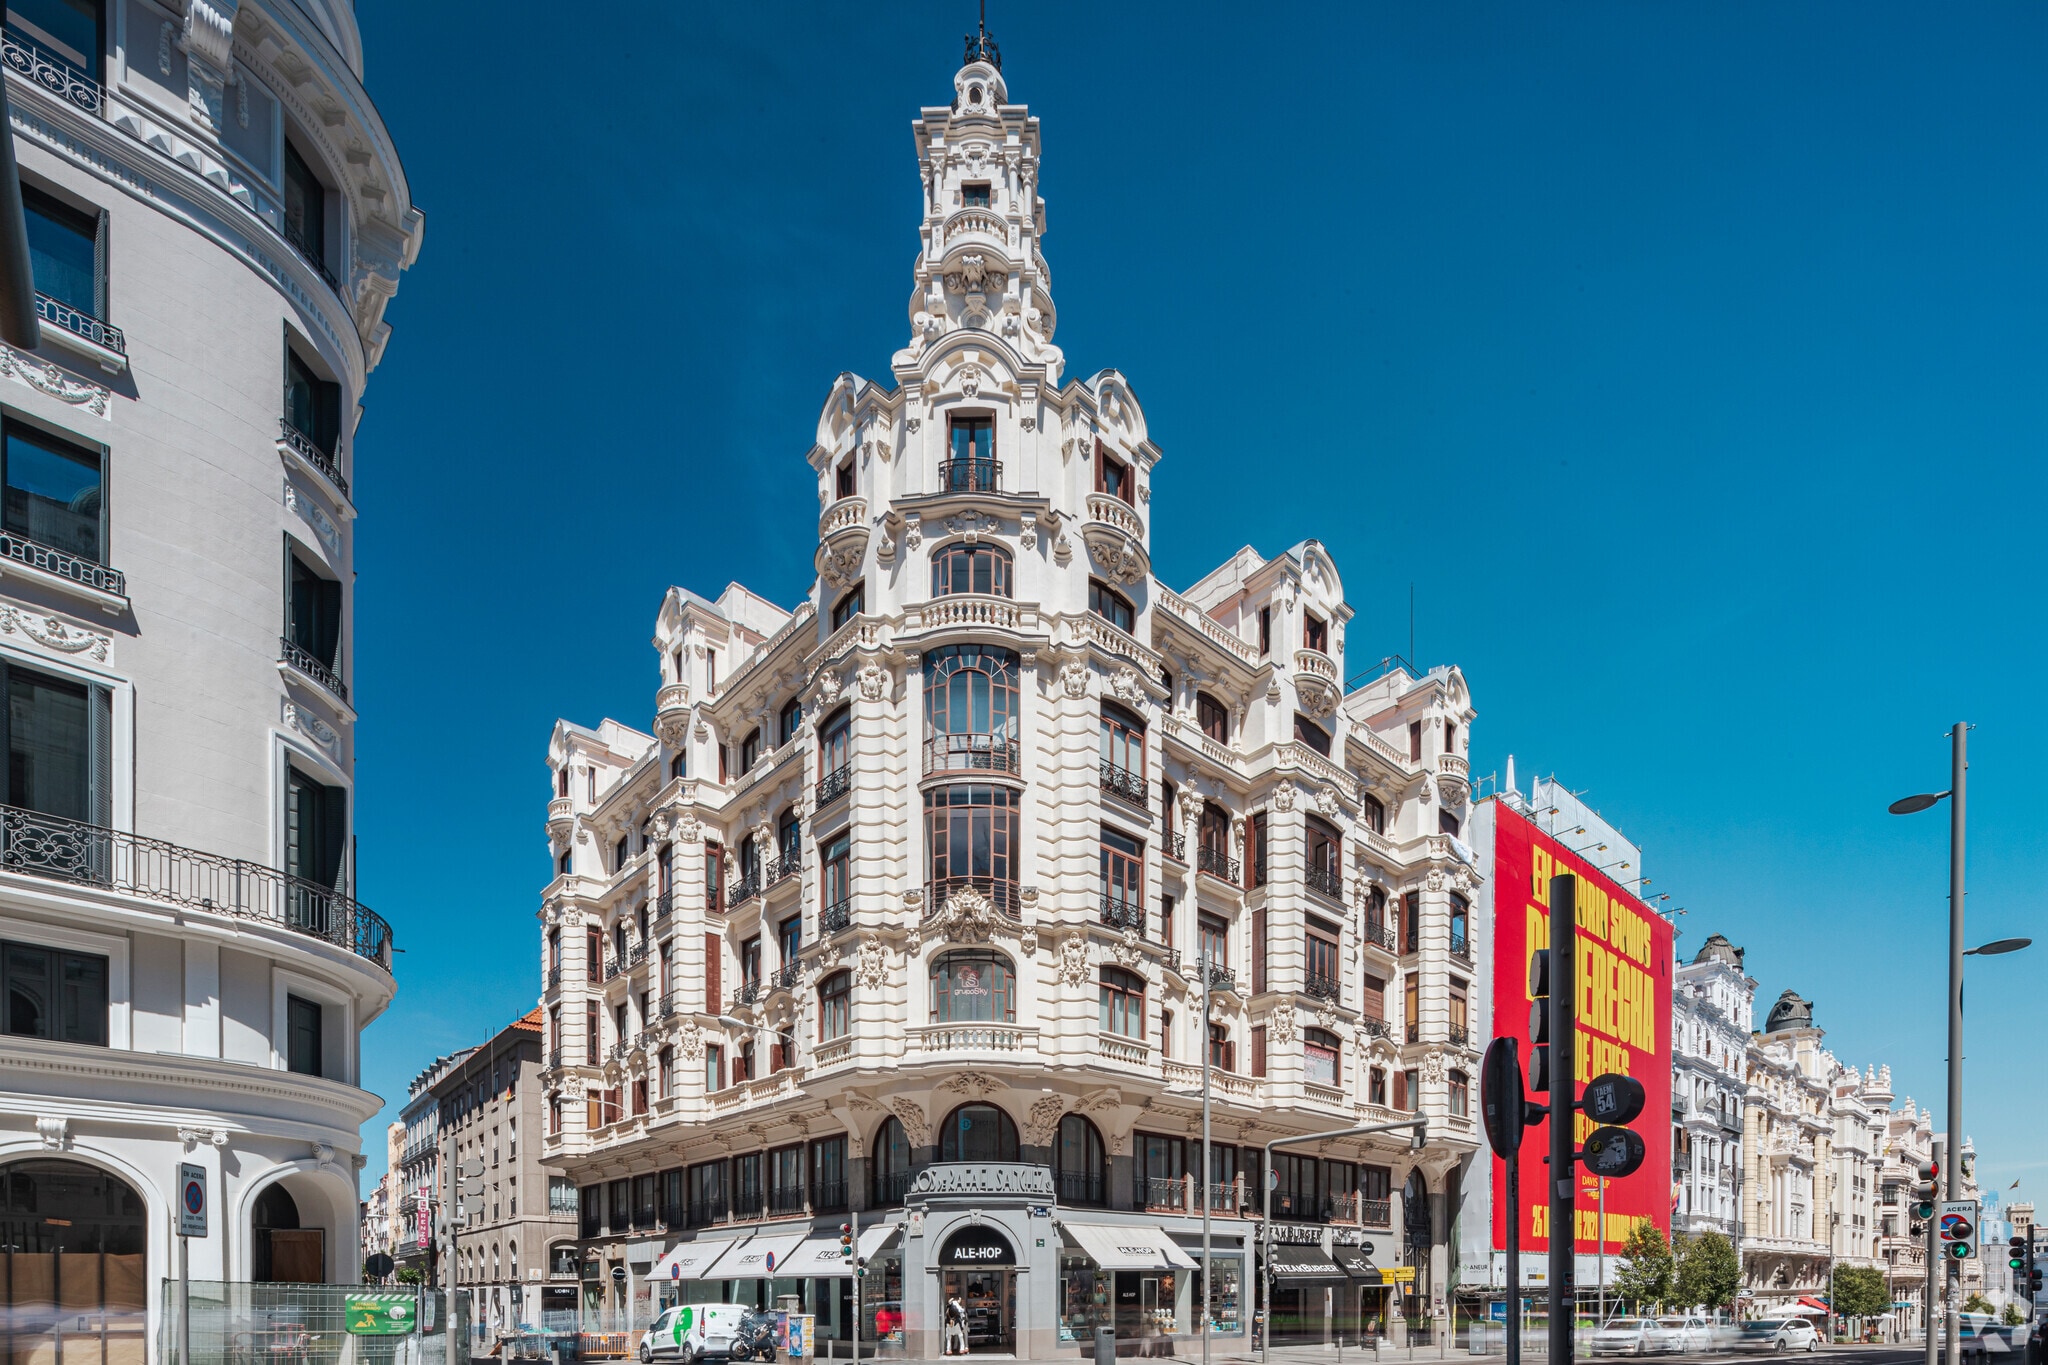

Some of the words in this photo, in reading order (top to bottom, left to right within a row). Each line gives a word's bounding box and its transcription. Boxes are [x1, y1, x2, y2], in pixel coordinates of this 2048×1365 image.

[1610, 898, 1651, 969] SOMOS
[954, 988, 989, 996] grupoSky
[1597, 1094, 1614, 1111] 54
[191, 1172, 204, 1180] ACERA
[948, 1168, 993, 1192] RAFAEL
[1582, 1175, 1598, 1187] DAVIS
[954, 1247, 1002, 1259] ALE-HOP
